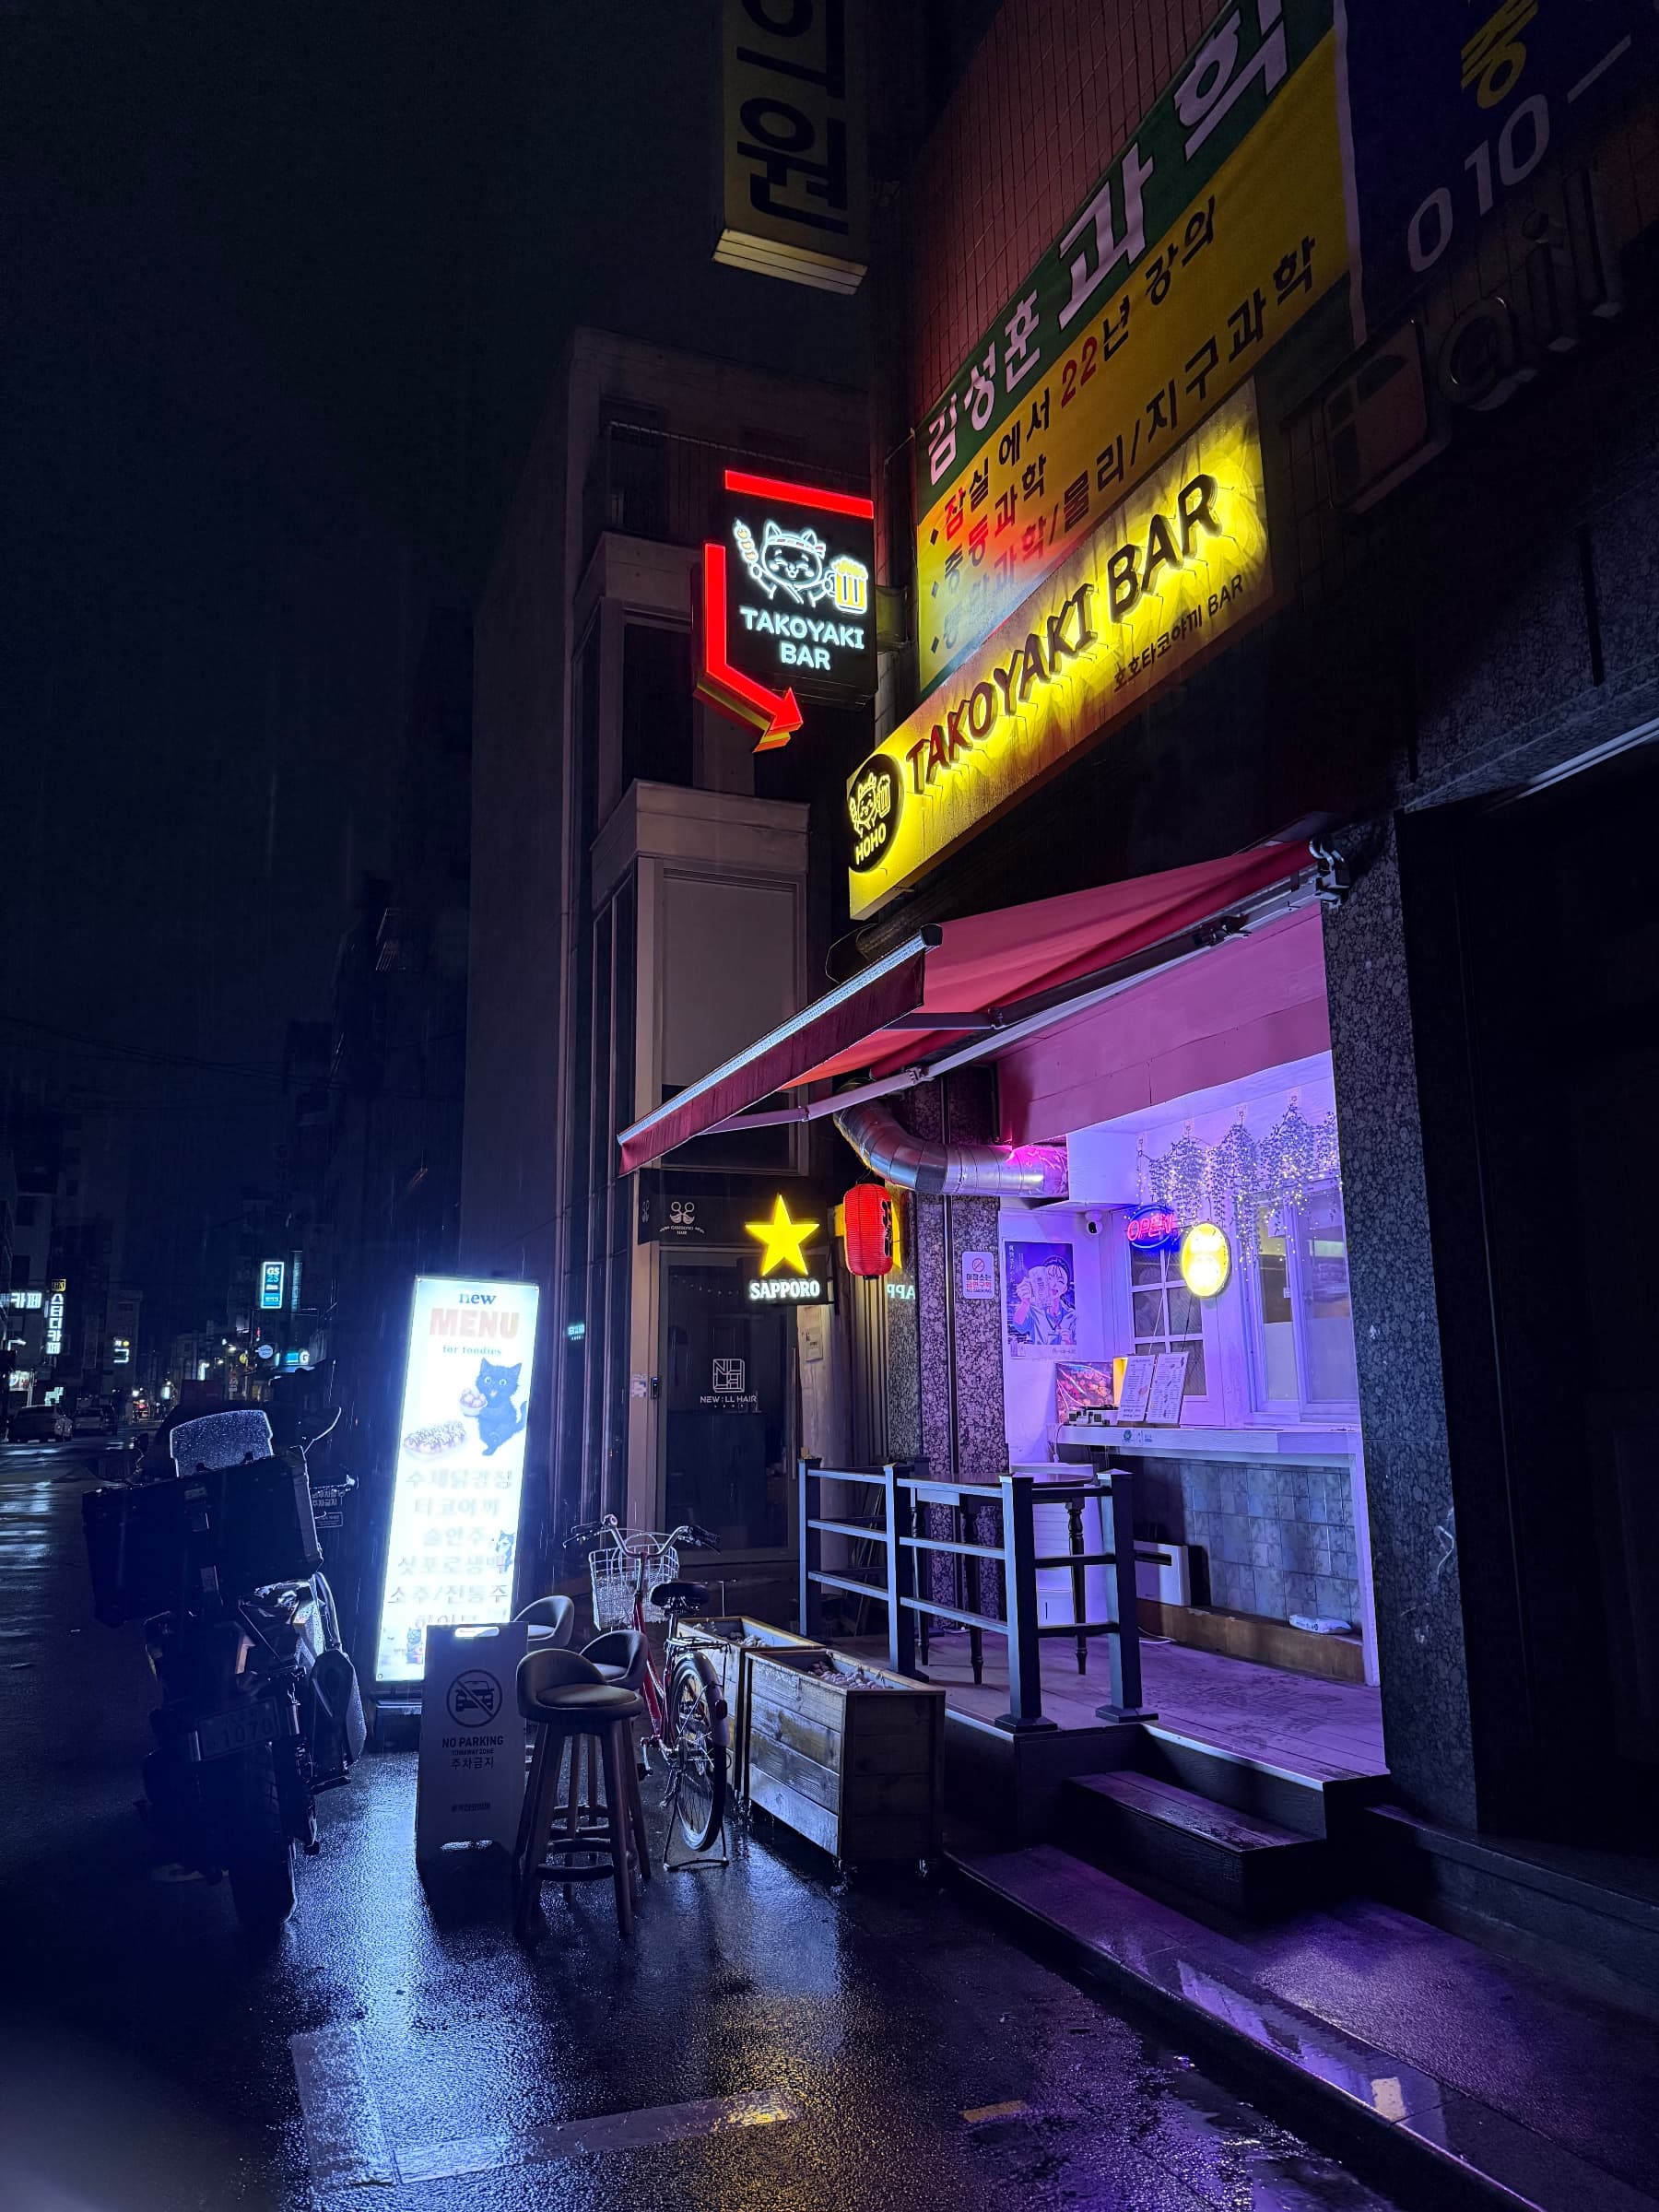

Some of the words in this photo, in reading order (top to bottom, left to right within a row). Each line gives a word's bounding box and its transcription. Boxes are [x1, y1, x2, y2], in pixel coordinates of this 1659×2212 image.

[928, 288, 1041, 487] 김성훈
[1058, 0, 1288, 333] 과학
[1061, 295, 1130, 409] 22년
[1144, 194, 1215, 305] 강의
[739, 606, 865, 650] TAKOYAKI
[906, 582, 1098, 794] TAKOYAKI
[1107, 474, 1222, 623] BAR
[1113, 604, 1203, 693] 호호타코야끼
[1208, 573, 1243, 618] BAR
[780, 642, 831, 671] BAR
[854, 822, 887, 865] HOHO
[1127, 1213, 1173, 1241] OPEN
[266, 1275, 279, 1283] 25
[748, 1279, 820, 1300] SAPPORO
[458, 1291, 498, 1305] new
[429, 1308, 520, 1339] MENU
[442, 1344, 459, 1354] for
[736, 1394, 758, 1403] HAIR
[442, 1738, 456, 1748] NO
[459, 1735, 504, 1747] PARKING
[451, 1756, 495, 1770] 주차금지
